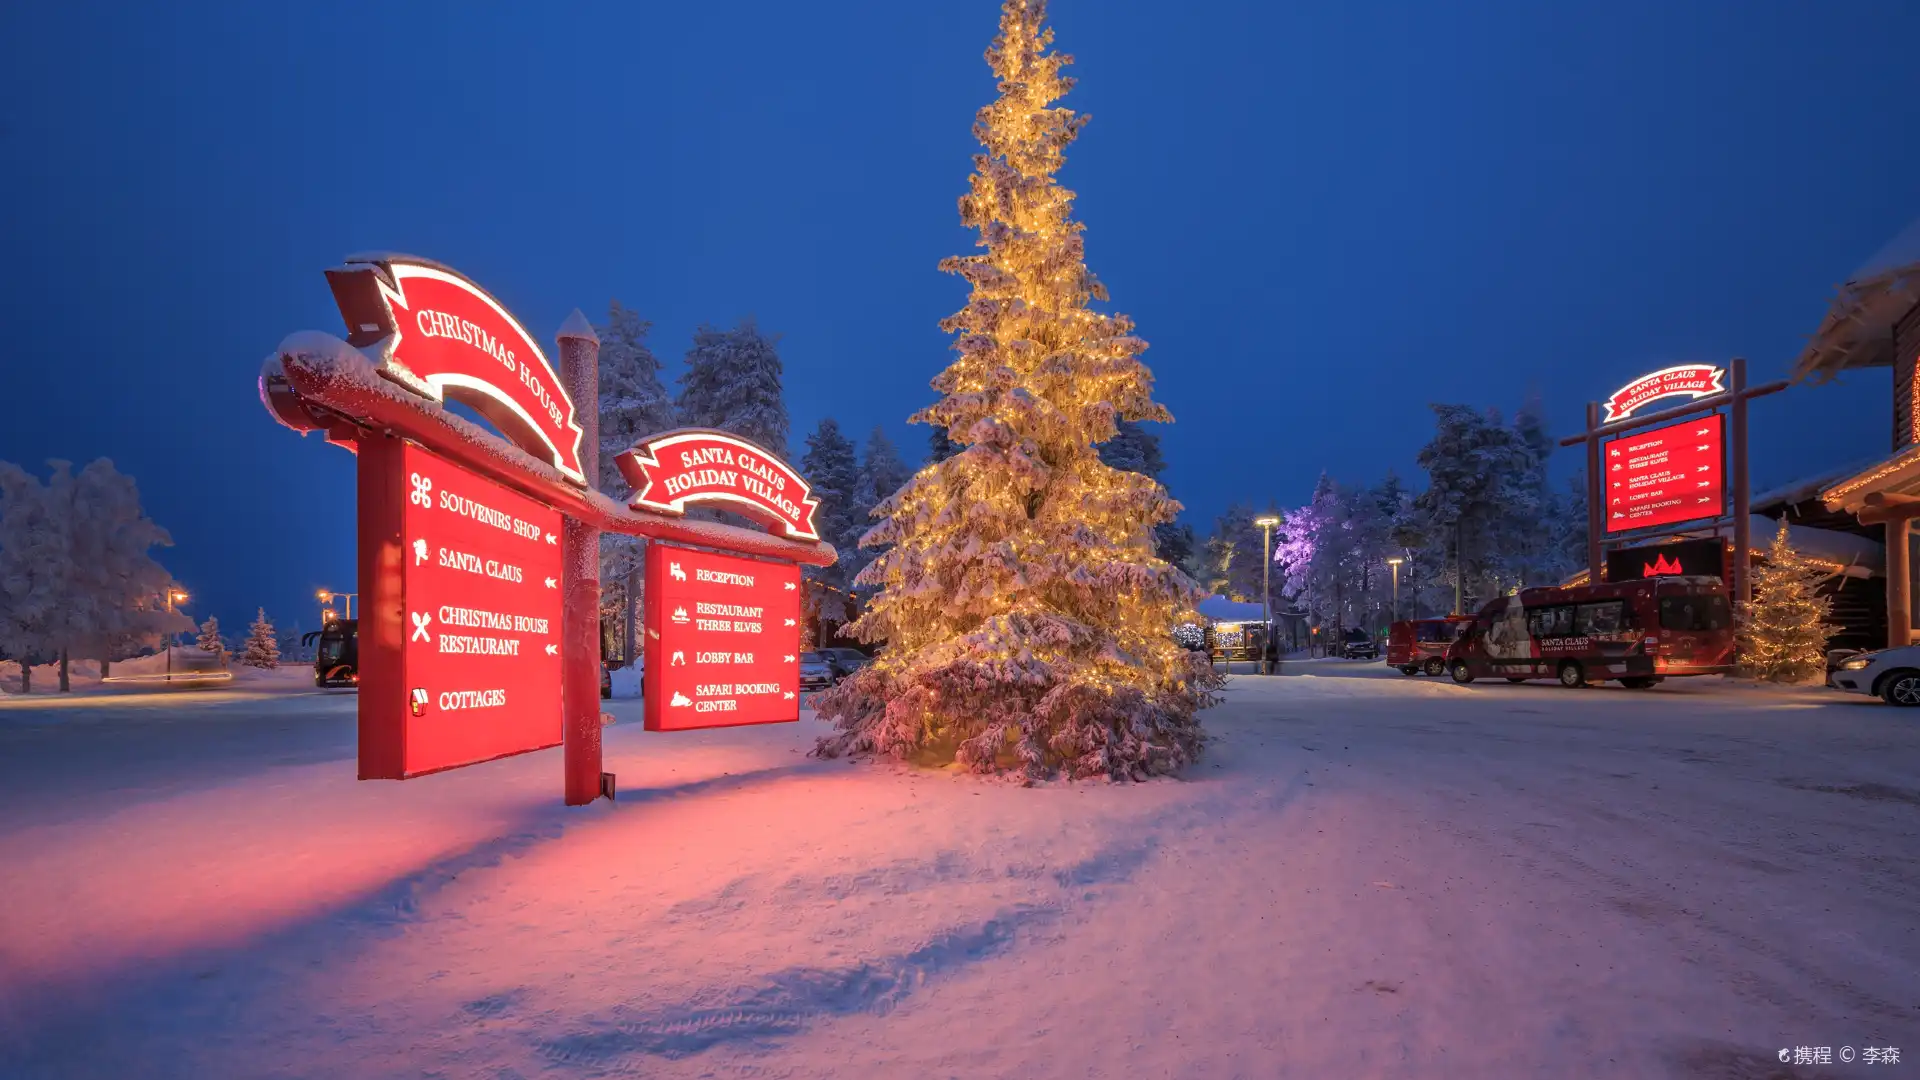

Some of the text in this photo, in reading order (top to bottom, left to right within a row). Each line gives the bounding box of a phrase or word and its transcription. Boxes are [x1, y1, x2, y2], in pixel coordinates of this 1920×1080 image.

[417, 310, 563, 428] CHRISTMAS HOUSE
[1630, 370, 1696, 396] SANTA CLAUS
[1620, 380, 1706, 411] HOLIDAY VILLAGE
[1629, 440, 1663, 452] RECEPTION
[1629, 451, 1669, 464] RESTAURANT
[680, 448, 785, 491] SANTA CLAUS
[1629, 471, 1670, 483] SANTA CLAUS
[1629, 474, 1685, 489] HOLIDAY VILLAGE
[664, 469, 801, 521] HOLIDAY VILLAGE
[1652, 499, 1681, 509] BOOKING
[440, 490, 541, 541] SOUVENIRS SHOP
[1630, 510, 1653, 518] CENTER
[439, 548, 523, 583] SANTA CLAUS
[696, 569, 754, 587] RECEPTION
[696, 602, 763, 618] RESTAURANT
[439, 606, 549, 634] CHRISTMAS HOUSE
[696, 619, 762, 633] THREE ELVES
[439, 635, 520, 656] RESTAURANT
[1542, 637, 1589, 646] SANTA CLAUS
[696, 652, 754, 664] LOBBY BAR
[696, 683, 780, 696] SAFARI BOOKING
[439, 689, 506, 711] COTTAGES
[696, 700, 737, 712] CENTER
